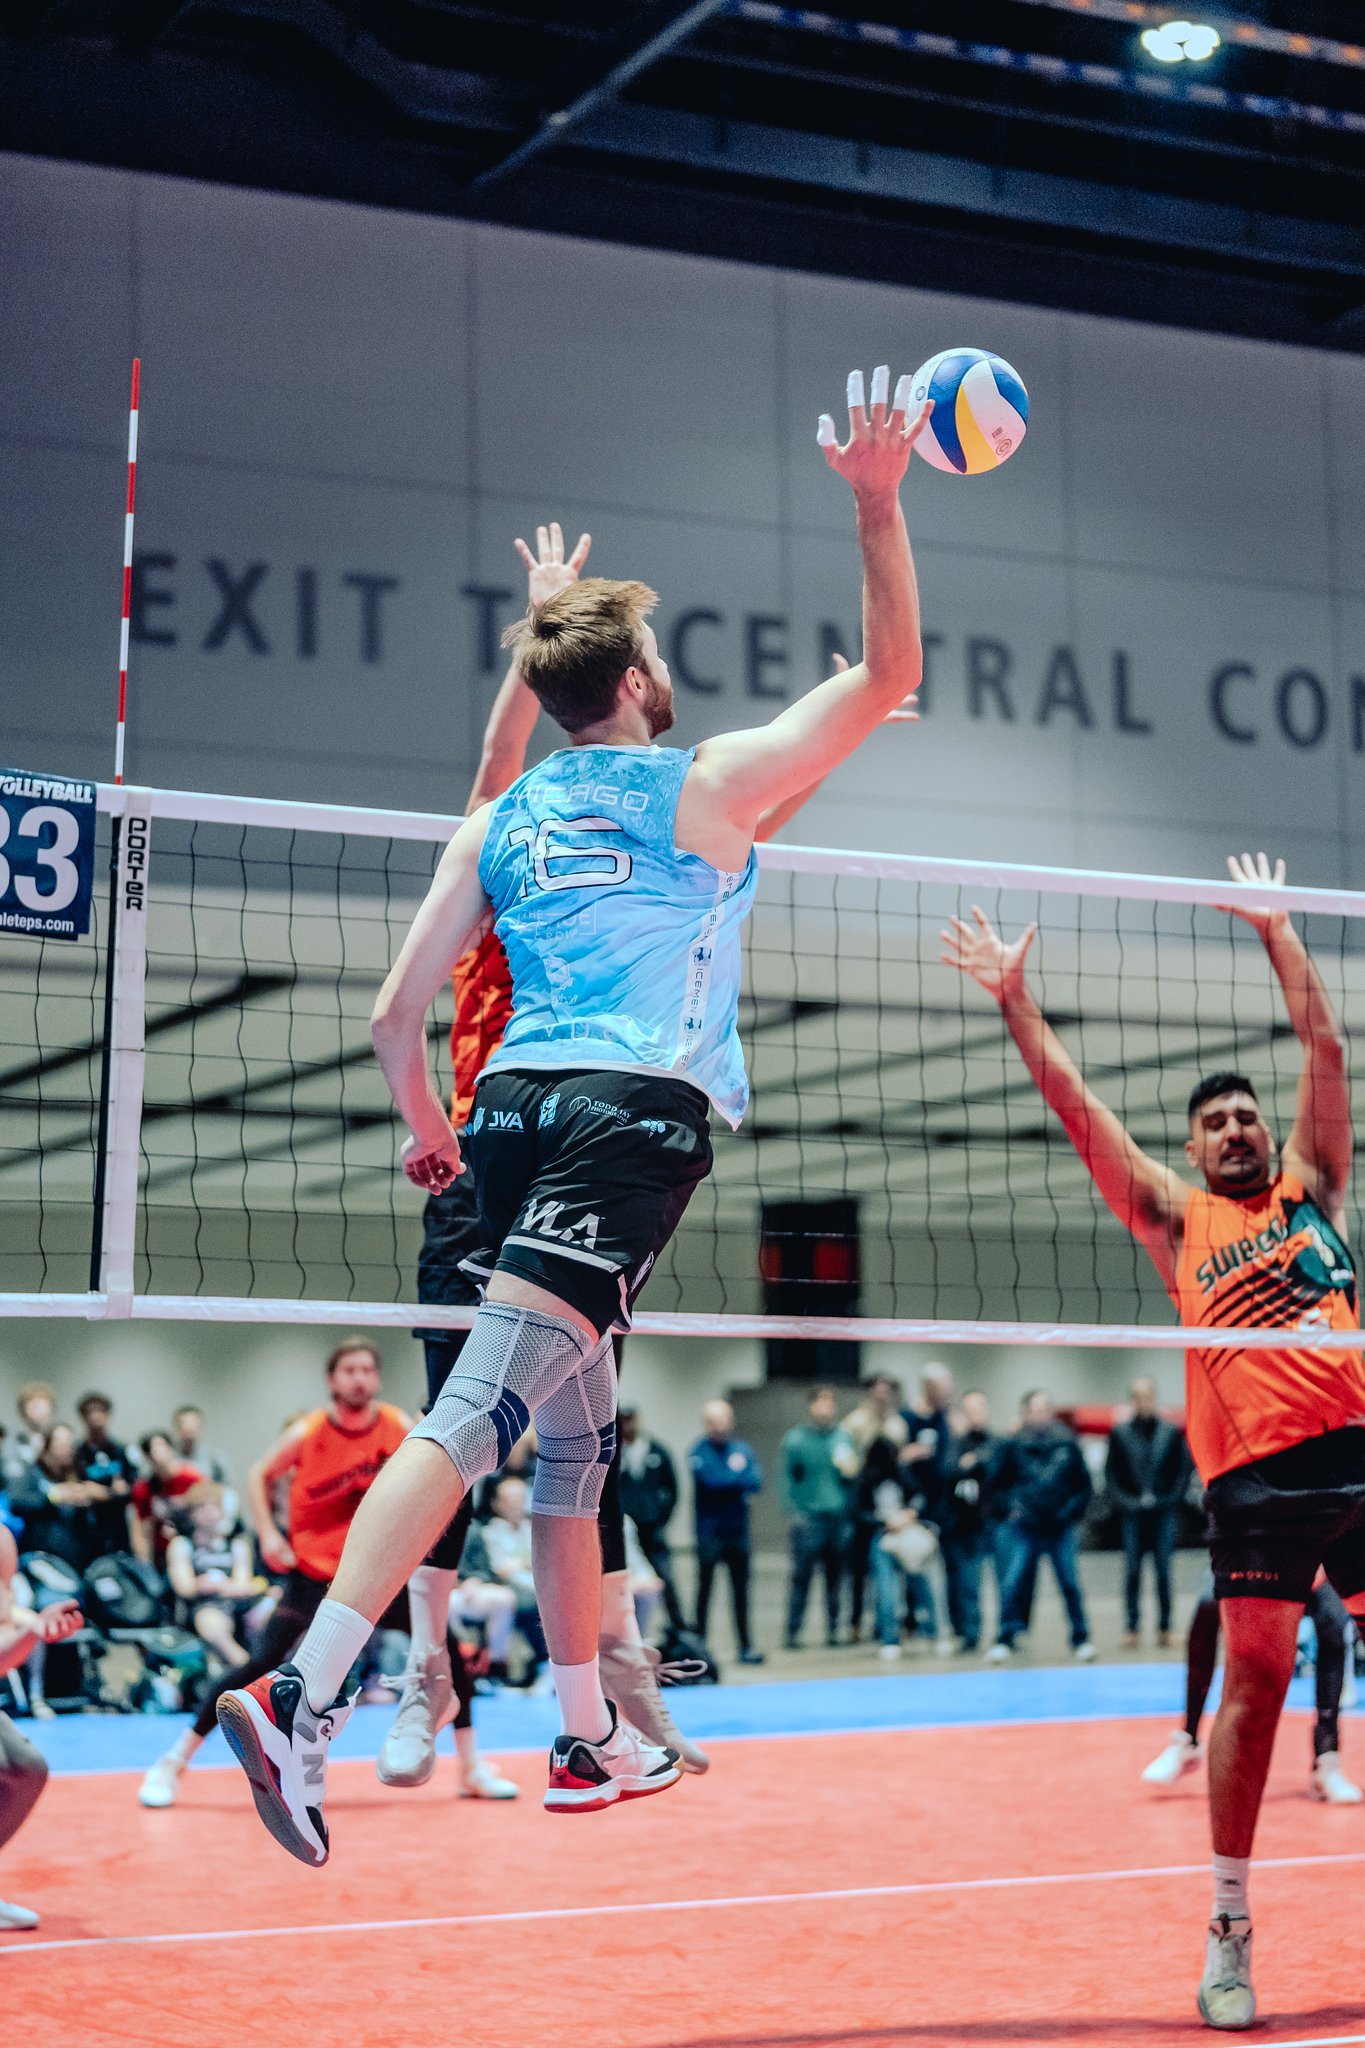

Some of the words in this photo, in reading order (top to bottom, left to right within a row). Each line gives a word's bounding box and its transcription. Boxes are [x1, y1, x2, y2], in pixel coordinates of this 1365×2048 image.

[130, 551, 398, 664] EXIT
[0, 805, 79, 912] 3
[508, 815, 632, 898] 16
[690, 968, 704, 1013] ICEMEN
[488, 1111, 524, 1130] JVA
[593, 1100, 618, 1112] TODD
